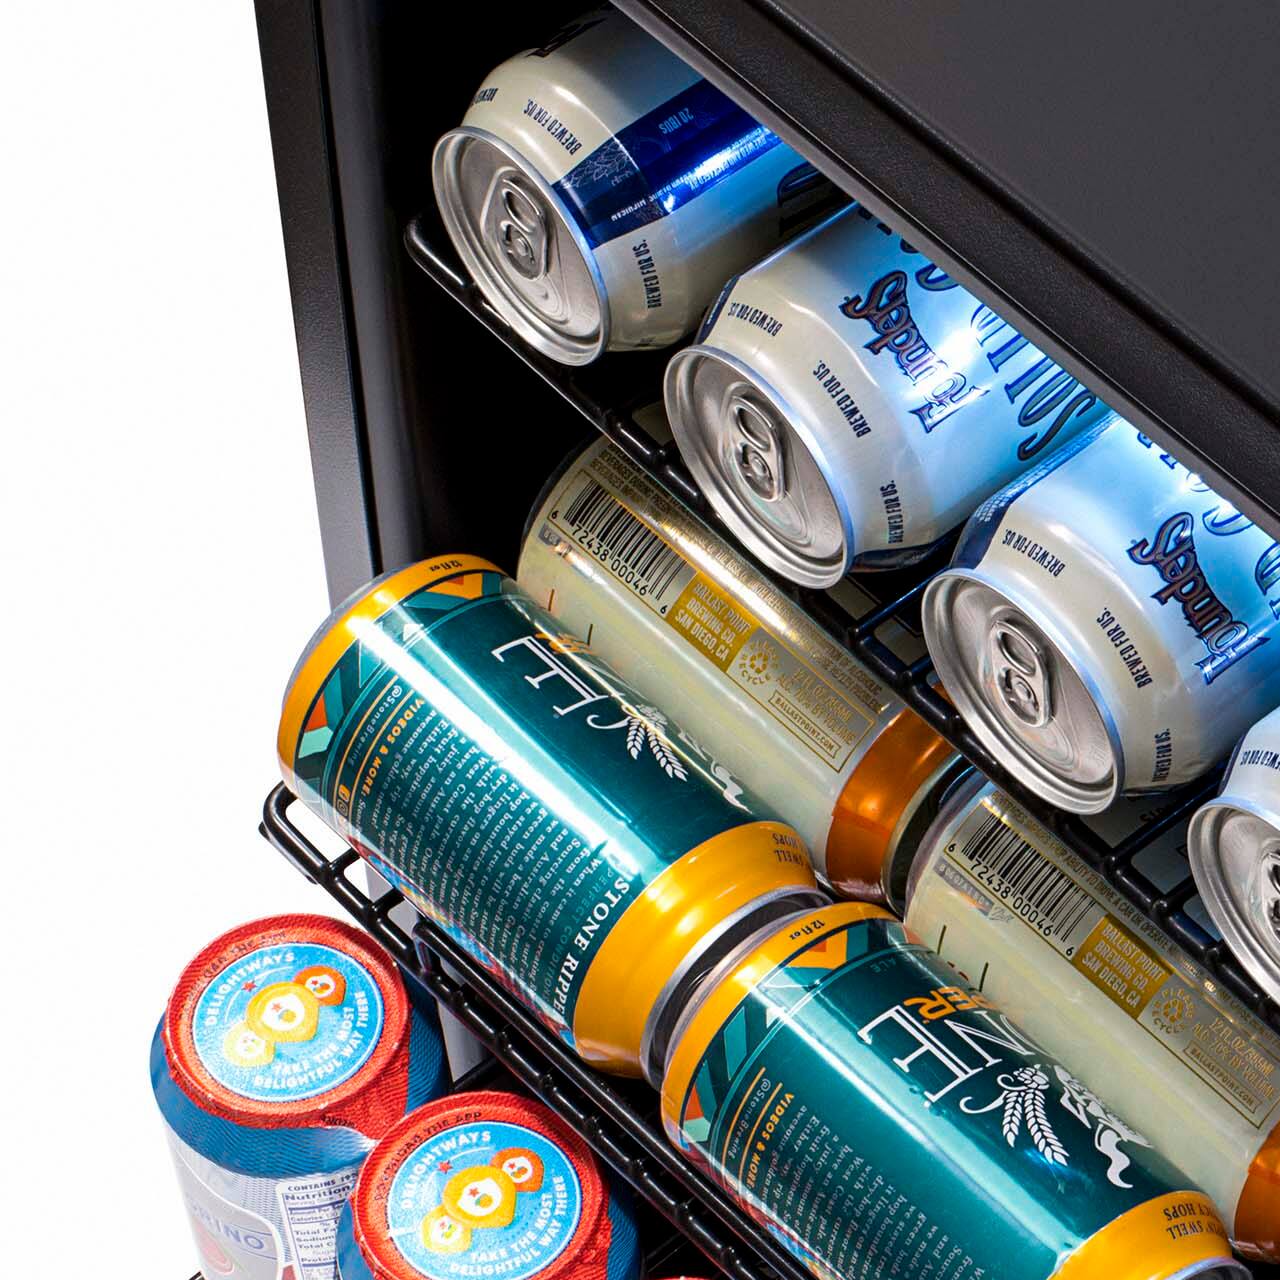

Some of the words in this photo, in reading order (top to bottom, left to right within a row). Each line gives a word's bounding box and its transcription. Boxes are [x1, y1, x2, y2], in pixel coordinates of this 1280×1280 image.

[538, 106, 551, 126] FOR
[547, 116, 582, 155] BREWED
[682, 108, 694, 124] 20
[639, 254, 657, 275] FOR
[643, 273, 661, 308] BREWED
[749, 308, 783, 336] BREWED
[813, 360, 831, 383] US.
[823, 375, 845, 398] FOR
[838, 395, 871, 438] BREWED
[885, 495, 901, 515] FOR
[888, 512, 903, 544] BREWED
[1013, 536, 1031, 556] FOR
[570, 523, 611, 561] 72438
[608, 558, 651, 597] 00046
[1028, 542, 1066, 577] BREWED
[684, 598, 724, 634] BREWING
[691, 581, 728, 615] BALLAST
[723, 607, 752, 635] POINT
[1097, 607, 1114, 631] US.
[673, 609, 694, 630] SAN
[688, 622, 719, 651] DIEGO,
[714, 644, 730, 661] CA
[1104, 625, 1127, 648] FOR
[1120, 638, 1153, 688] BREWED
[384, 696, 424, 744] VIDEOS
[359, 756, 383, 797] MORE:
[463, 754, 489, 780] West
[474, 763, 498, 789] with
[470, 771, 507, 815] dry-hop
[478, 791, 512, 831] lingers
[520, 806, 548, 840] green
[538, 836, 581, 887] Sourcing
[571, 875, 631, 951] STONE
[968, 858, 1013, 899] 72438
[1010, 896, 1055, 938] 00046
[1092, 940, 1135, 979] BREWING
[1130, 973, 1150, 993] CO.
[1101, 923, 1140, 958] BALLAST
[1135, 952, 1165, 981] POINT
[204, 952, 294, 1027] DELIGHTWAYS
[1080, 951, 1103, 974] SAN
[1097, 966, 1130, 997] DIEGO,
[1124, 989, 1141, 1007] CA
[254, 1061, 344, 1089] DELIGHTFUL
[340, 1031, 363, 1058] WAY
[355, 991, 369, 1028] THERE
[273, 1058, 310, 1075] TAKE
[315, 1045, 340, 1066] THE
[339, 1007, 354, 1042] MOST
[454, 1112, 482, 1125] APP
[759, 1090, 794, 1140] VIDEOS
[401, 1131, 491, 1209] DELIGHTWAYS
[286, 1186, 351, 1201] Nutrition
[1164, 1204, 1195, 1220] HOPS
[451, 1248, 541, 1276] DELIGHTFUL
[539, 1218, 562, 1246] WAY
[553, 1175, 568, 1216] THERE
[470, 1246, 507, 1263] TAKE
[511, 1230, 537, 1253] THE
[535, 1193, 553, 1229] MOST
